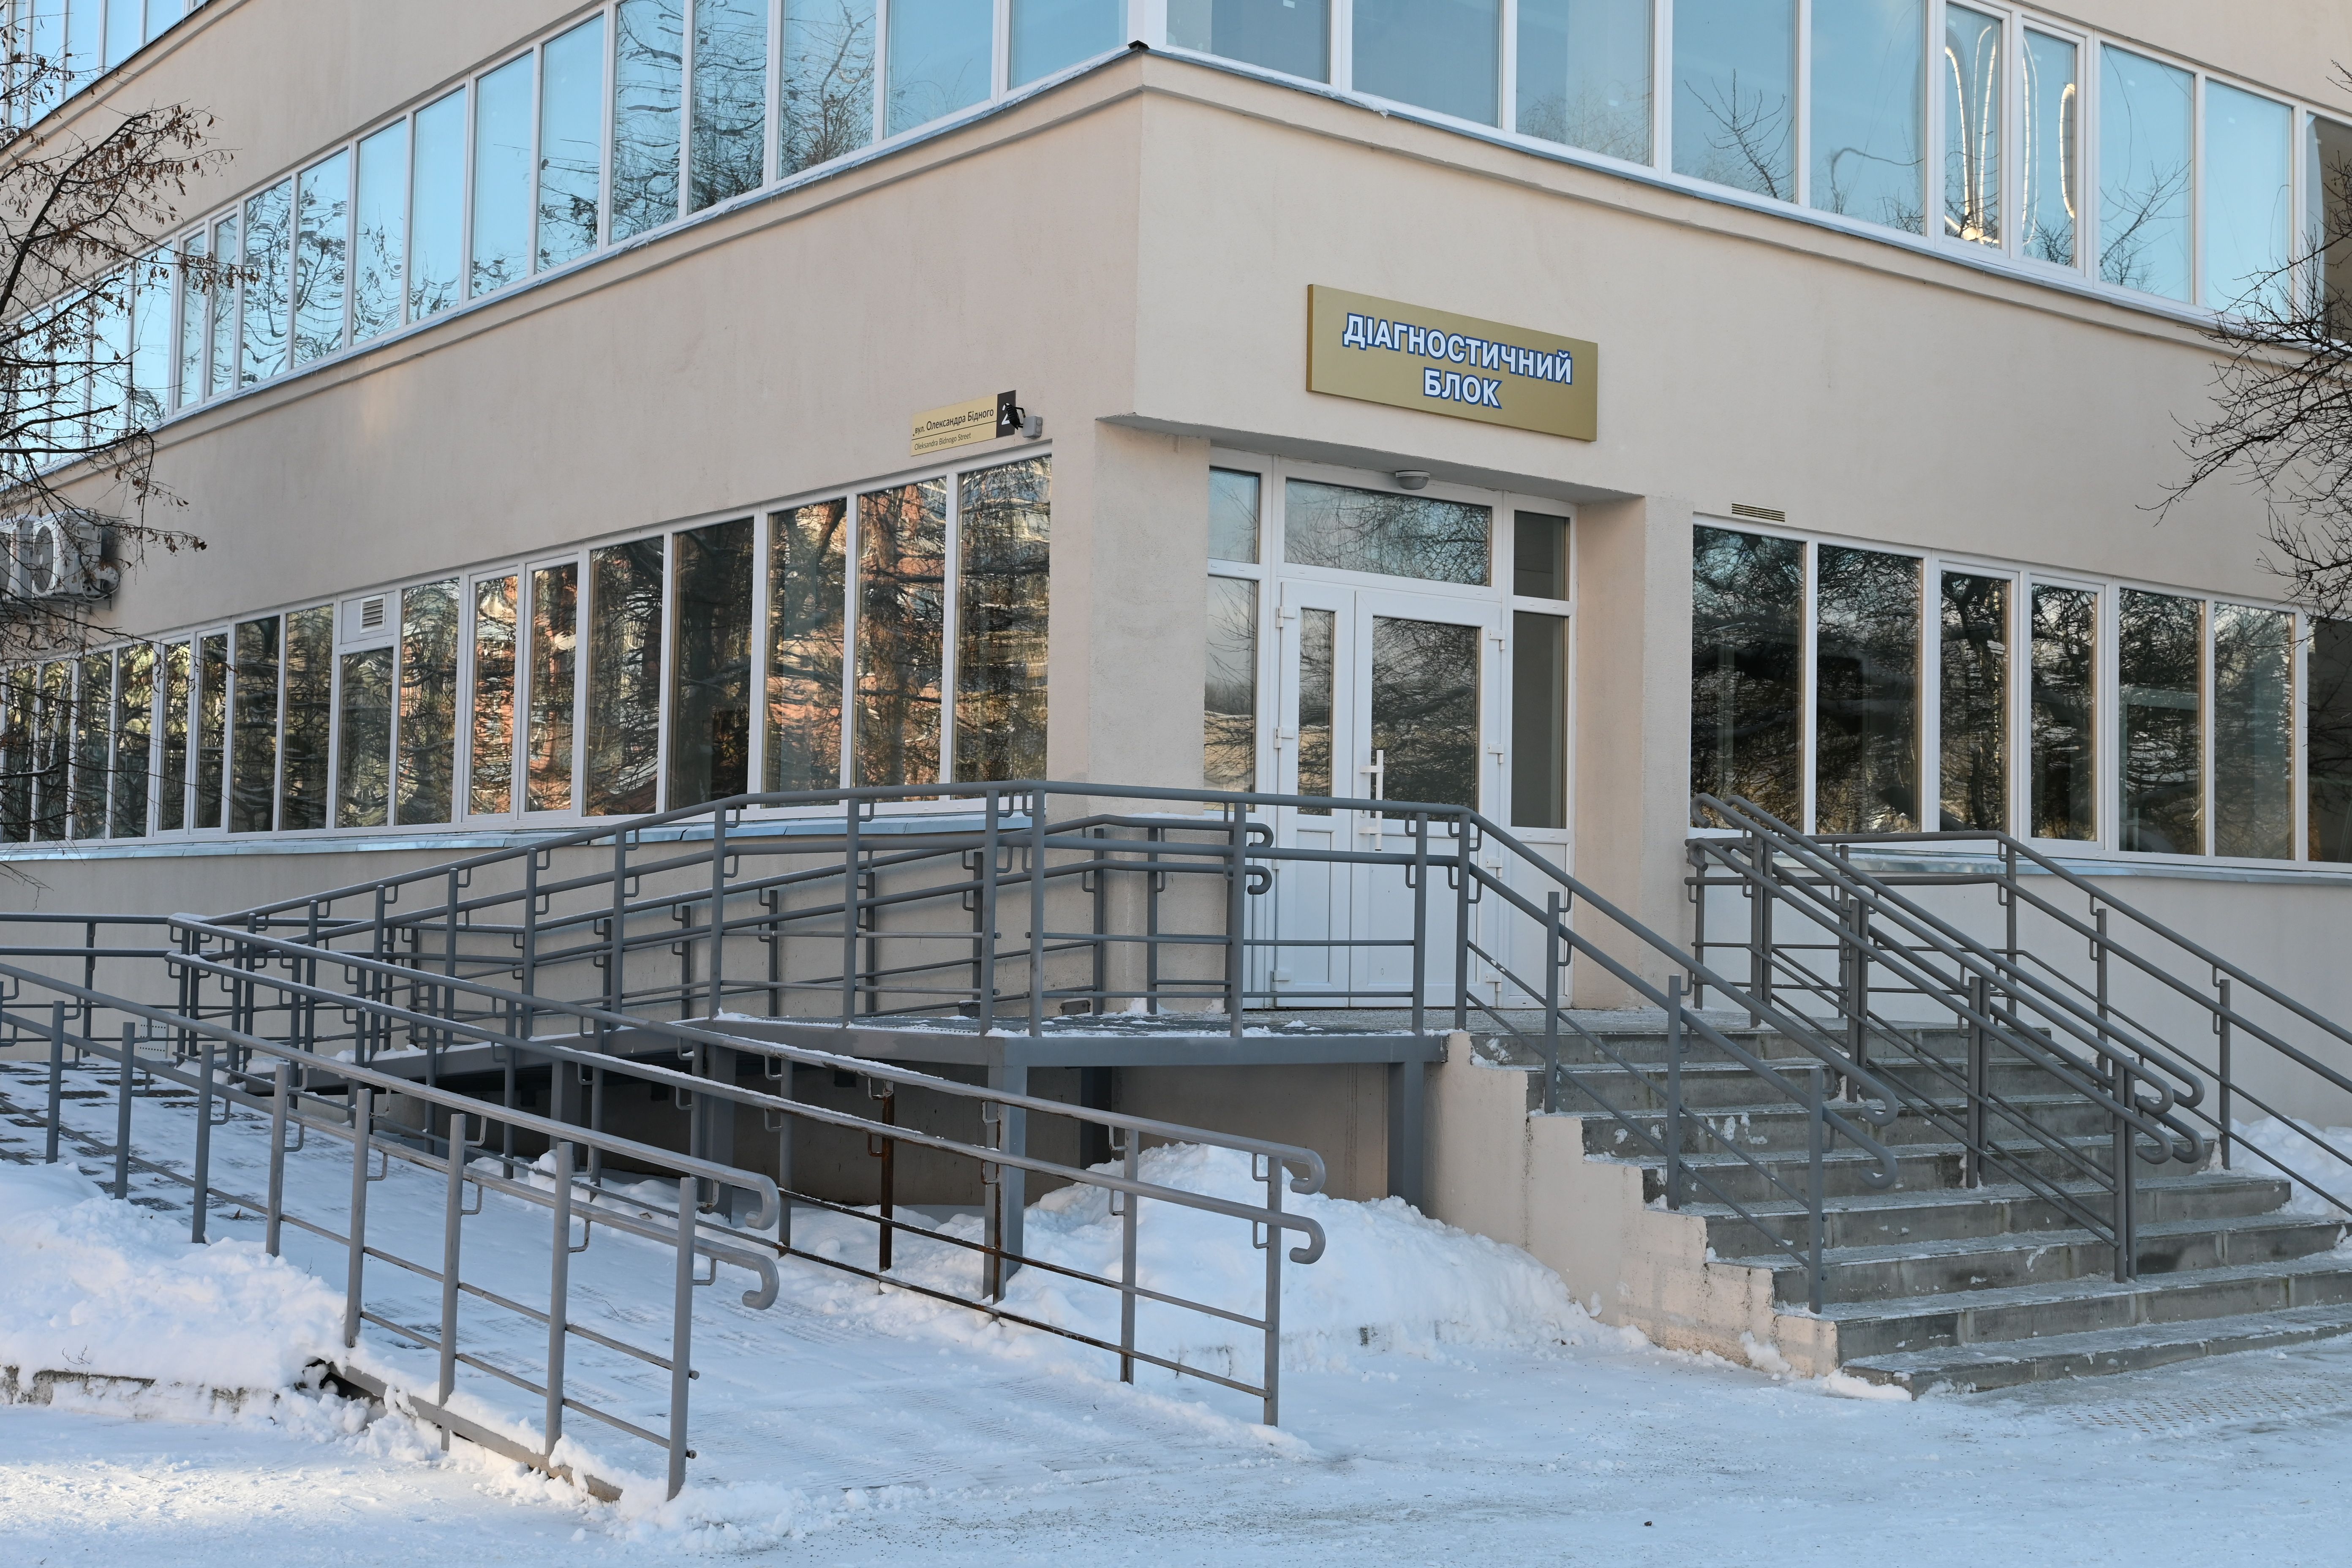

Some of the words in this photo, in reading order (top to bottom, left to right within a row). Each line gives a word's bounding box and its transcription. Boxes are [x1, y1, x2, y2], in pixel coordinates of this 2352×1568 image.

[1342, 313, 1572, 385] ДІАГНОСТИЧНИЙ
[1423, 367, 1503, 409] БЛОК
[915, 425, 925, 434] вул.
[926, 415, 966, 431] Олександра
[967, 408, 994, 422] Бідного
[914, 438, 938, 450] Oleksandra
[939, 435, 957, 446] Bidnogo
[958, 433, 971, 441] Street
